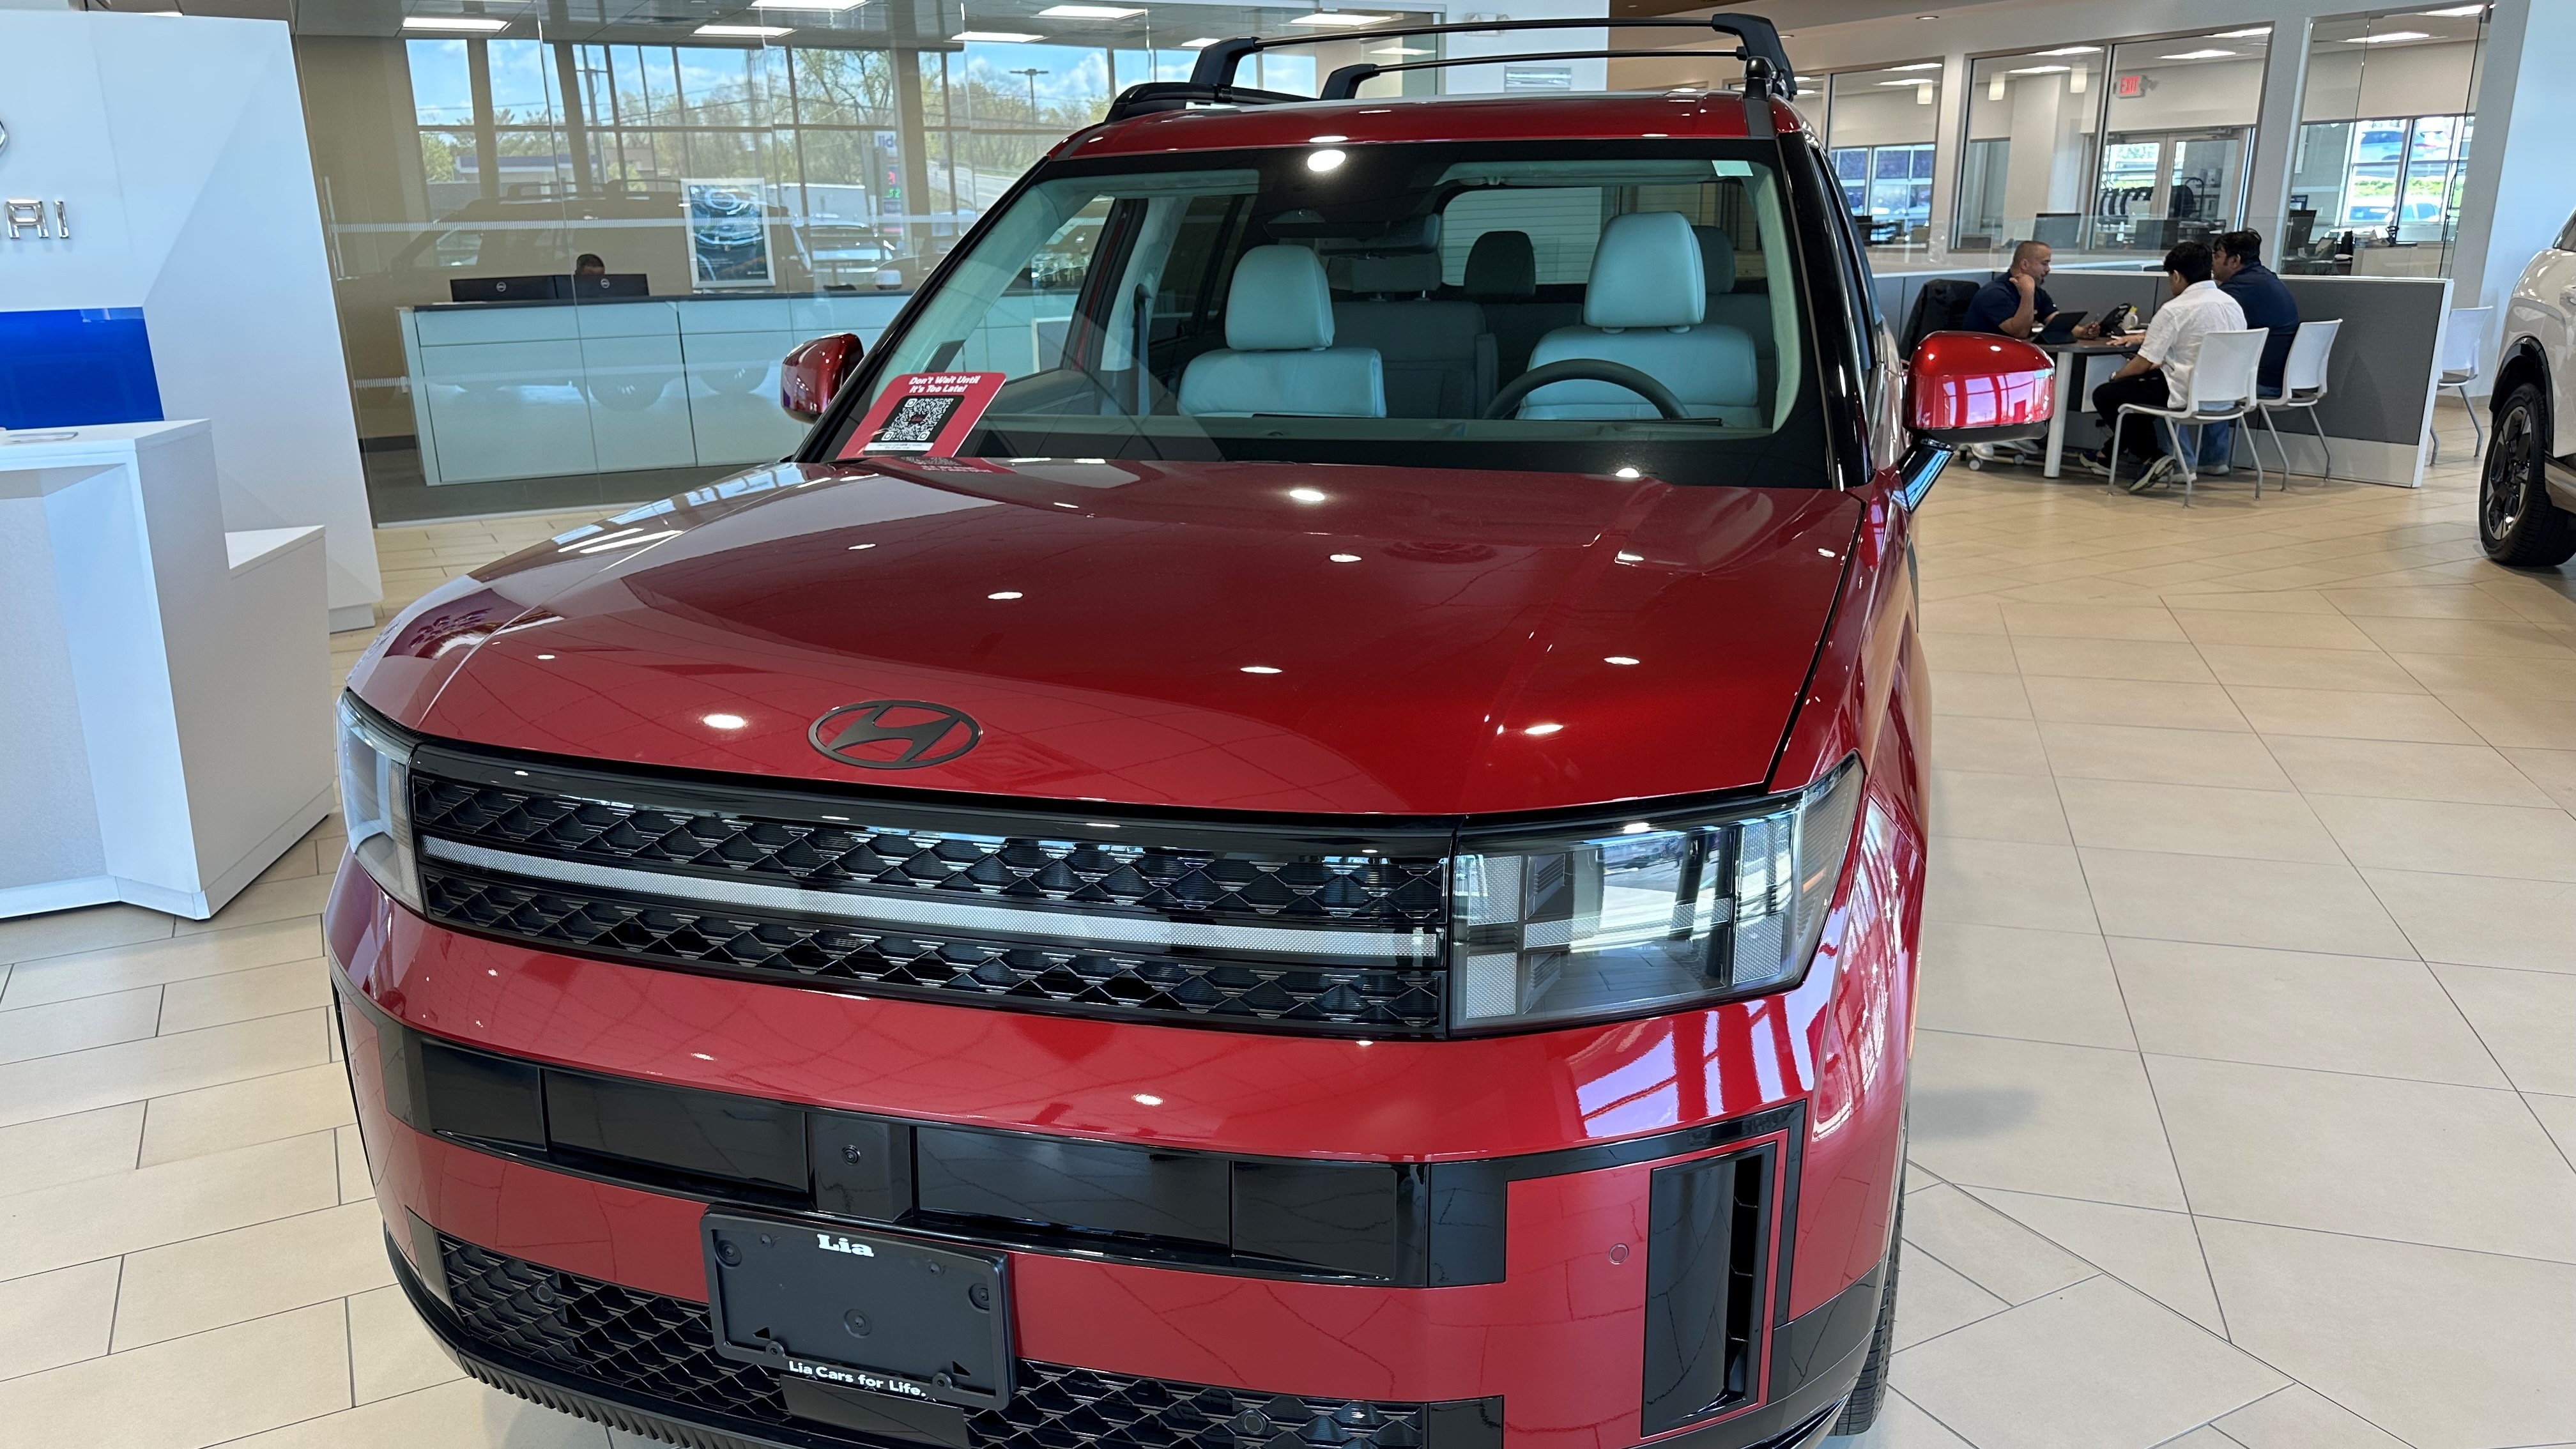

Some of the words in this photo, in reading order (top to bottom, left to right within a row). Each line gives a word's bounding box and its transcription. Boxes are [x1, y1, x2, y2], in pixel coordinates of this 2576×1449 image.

[2119, 75, 2140, 95] EXIT
[908, 376, 934, 385] Don't
[935, 375, 957, 384] Wait
[956, 375, 981, 384] Until
[908, 385, 925, 394] It's
[926, 384, 942, 393] Too
[942, 384, 969, 393] Late!
[816, 1234, 875, 1257] Lia
[788, 1360, 813, 1375] Lia
[815, 1365, 854, 1383] Cars
[857, 1374, 884, 1388] for
[889, 1379, 926, 1397] Life.
